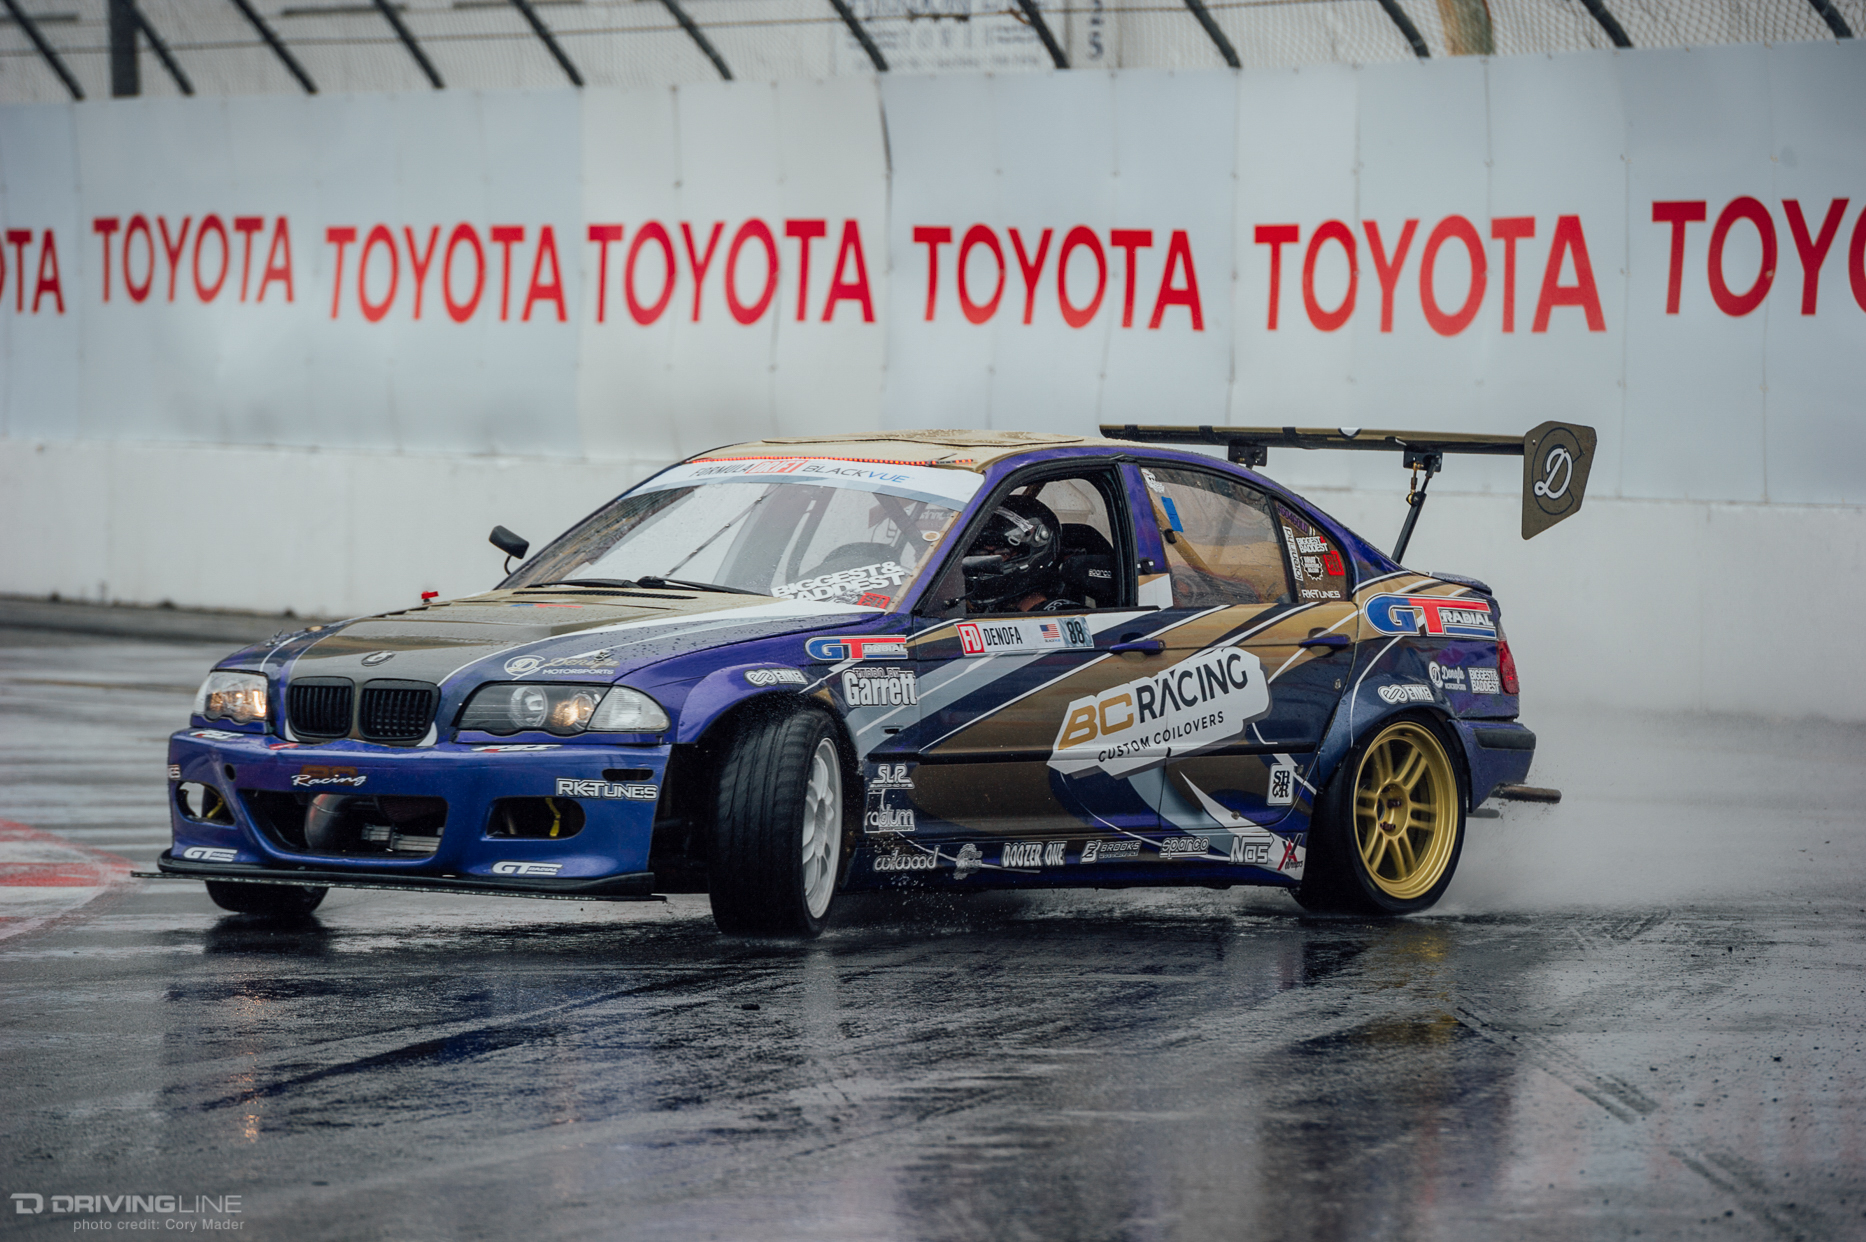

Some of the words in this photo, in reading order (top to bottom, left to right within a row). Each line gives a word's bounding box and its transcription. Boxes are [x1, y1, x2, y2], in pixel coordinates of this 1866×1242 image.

[0, 228, 65, 314] TA
[93, 213, 295, 302] TOYOTA
[325, 222, 568, 322] TOYOTA
[587, 218, 875, 326] TOYOTA
[912, 223, 1205, 331] TOYOTA
[1254, 214, 1606, 337] TOYOTA
[1651, 195, 1866, 317] TOY
[690, 463, 755, 477] FORMULA
[802, 465, 908, 483] BLACKVUE
[1442, 610, 1493, 626] RADIAL
[958, 624, 983, 652] FD
[983, 626, 1023, 646] DENOFA
[1066, 621, 1086, 644] 88
[844, 671, 918, 706] Garrett
[1135, 653, 1249, 723] RACING
[1098, 736, 1151, 762] CUSTOM
[1153, 711, 1225, 744] COILOVERS
[291, 774, 367, 787] Racing
[1273, 770, 1290, 783] SH
[873, 845, 940, 870] wilwood
[1003, 843, 1042, 867] DOOZER
[1044, 842, 1066, 866] ONE
[1101, 842, 1140, 852] BROOKS
[1161, 838, 1211, 859] sparco
[1230, 834, 1275, 864] NOS
